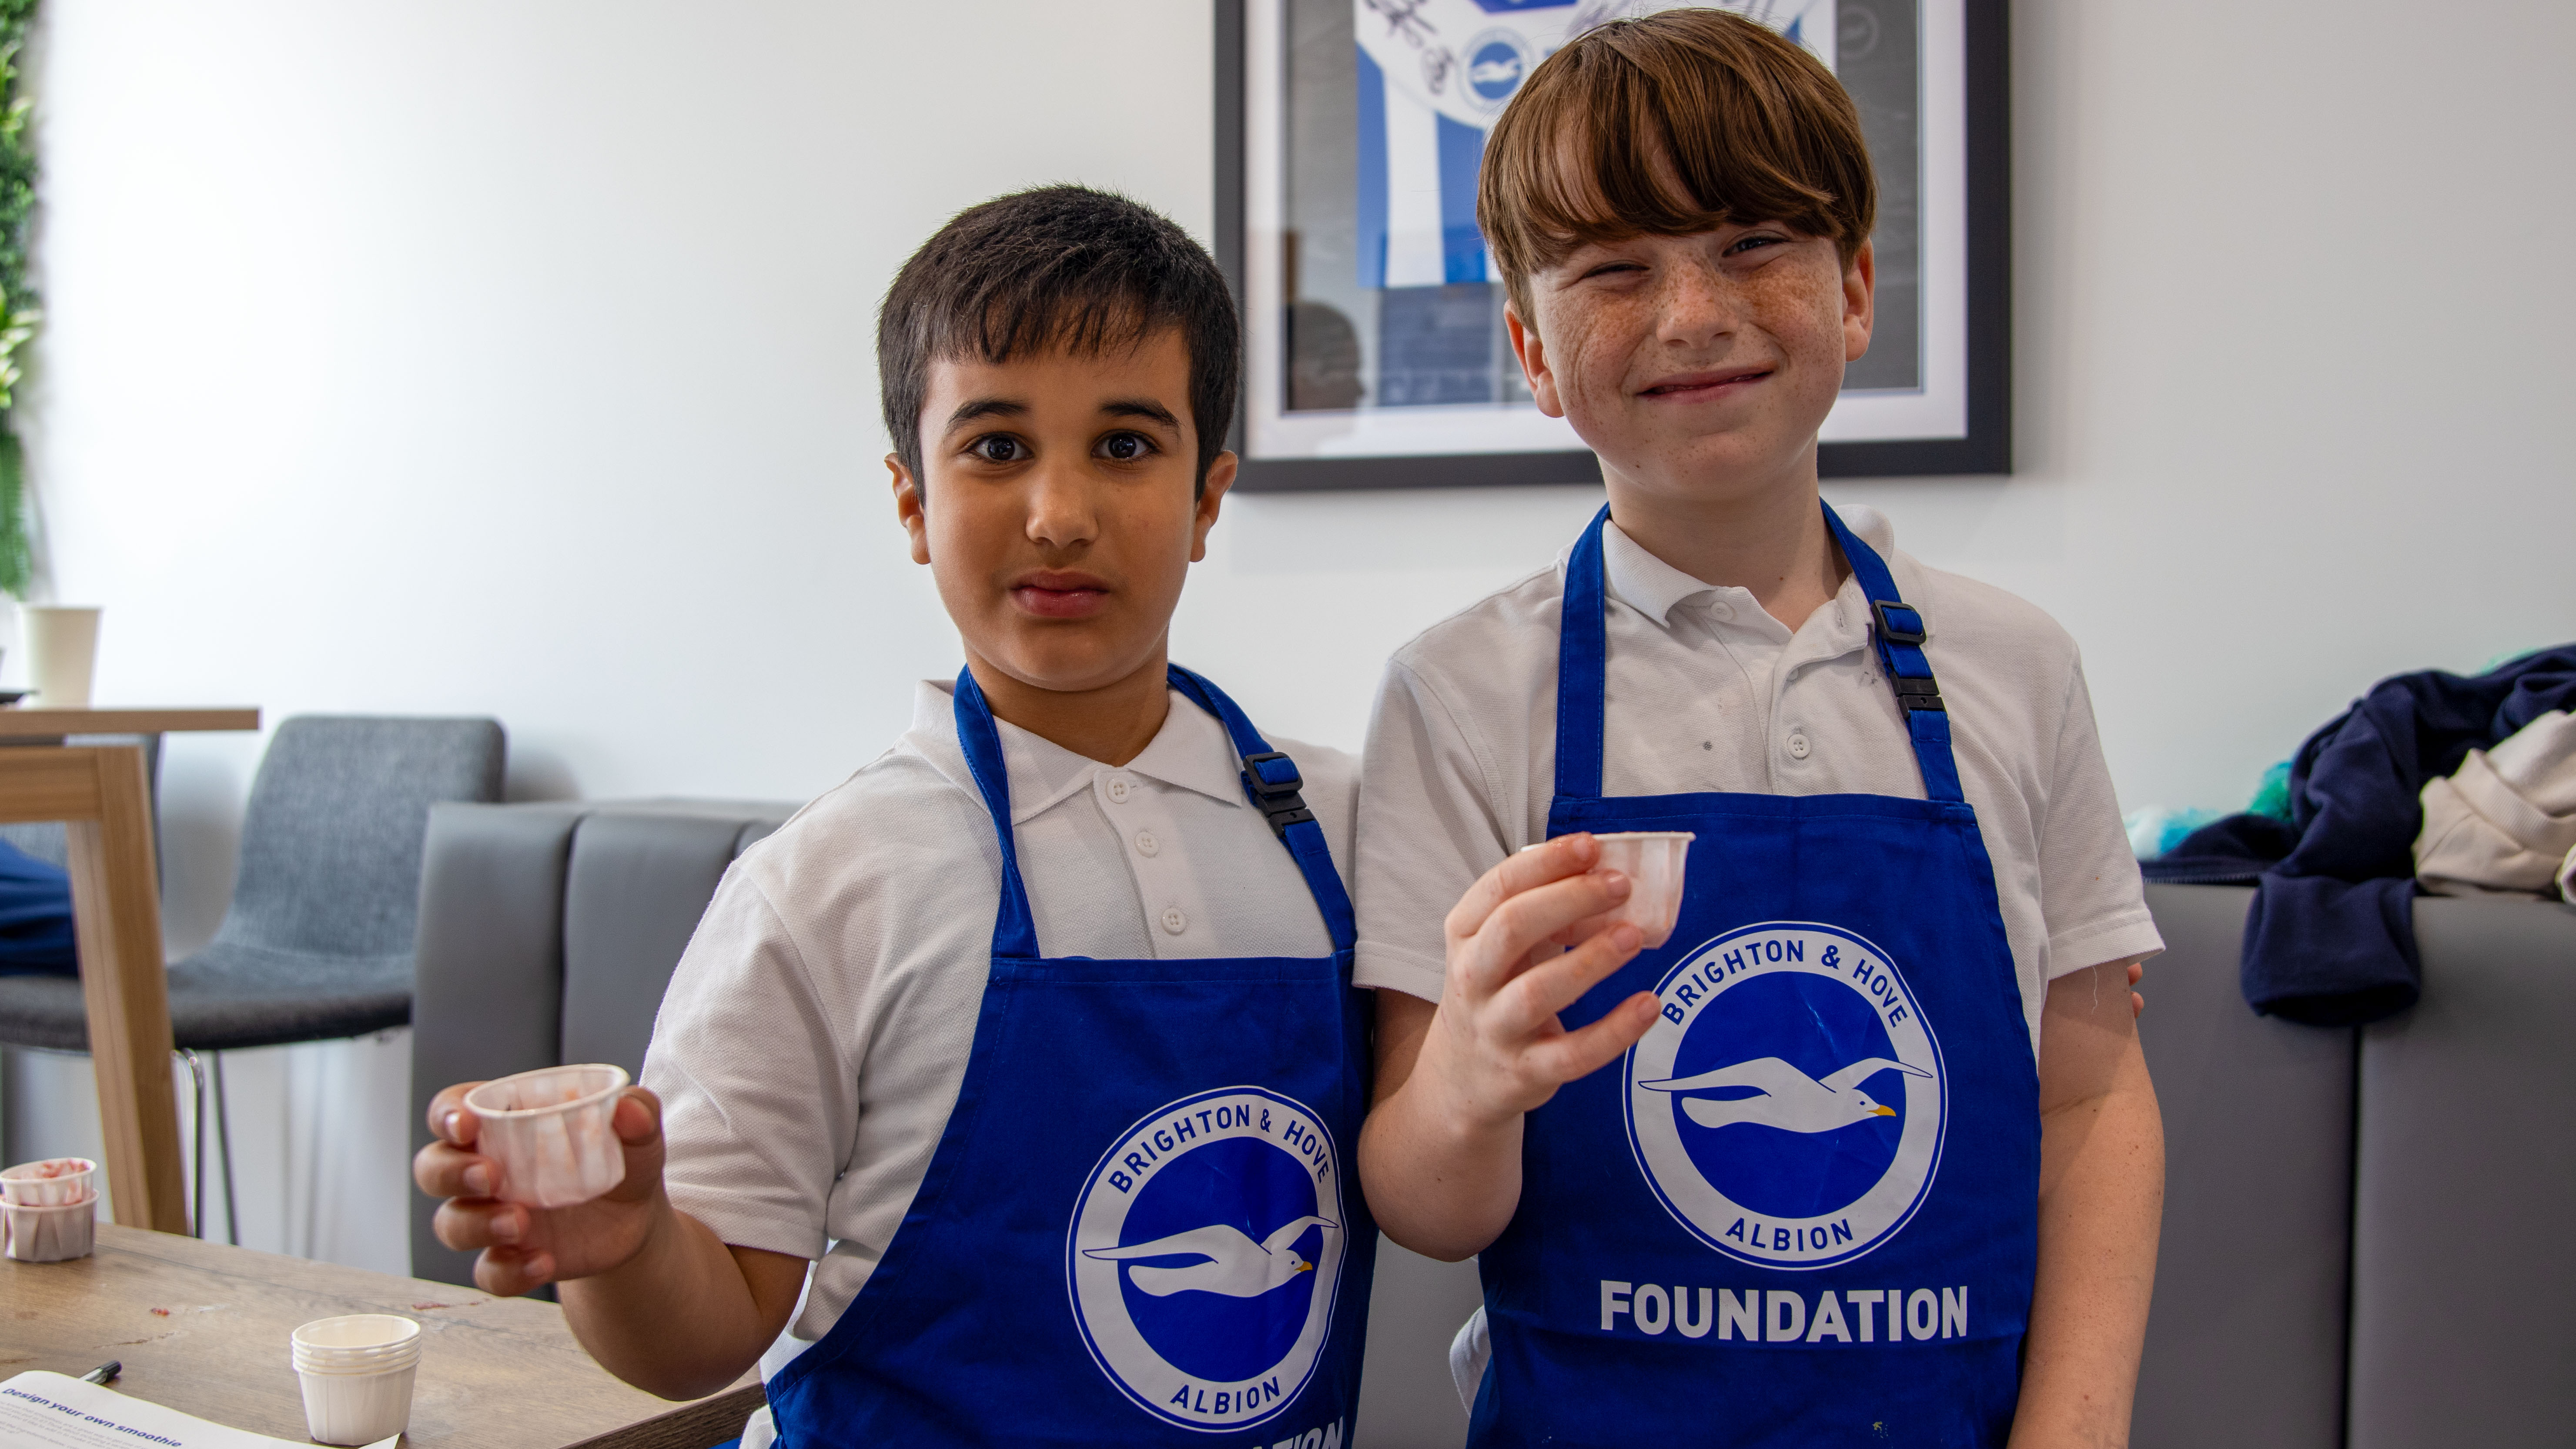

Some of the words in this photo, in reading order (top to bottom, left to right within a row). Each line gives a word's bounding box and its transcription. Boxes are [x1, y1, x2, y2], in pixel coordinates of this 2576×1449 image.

[1662, 940, 1803, 1025] BRIGHTON
[1821, 945, 1840, 969] &
[1852, 959, 1908, 1028] HOVE
[1108, 1104, 1250, 1194] BRIGHTON
[1260, 1108, 1271, 1132] &
[1283, 1120, 1329, 1184] HOVE
[1725, 1218, 1853, 1252] ALBION
[1600, 1279, 1967, 1342] FOUNDATION
[3, 1388, 50, 1405] Design
[48, 1402, 85, 1416] your
[84, 1416, 115, 1428] own
[115, 1426, 182, 1447] smoothie
[1170, 1376, 1280, 1415] ALBION
